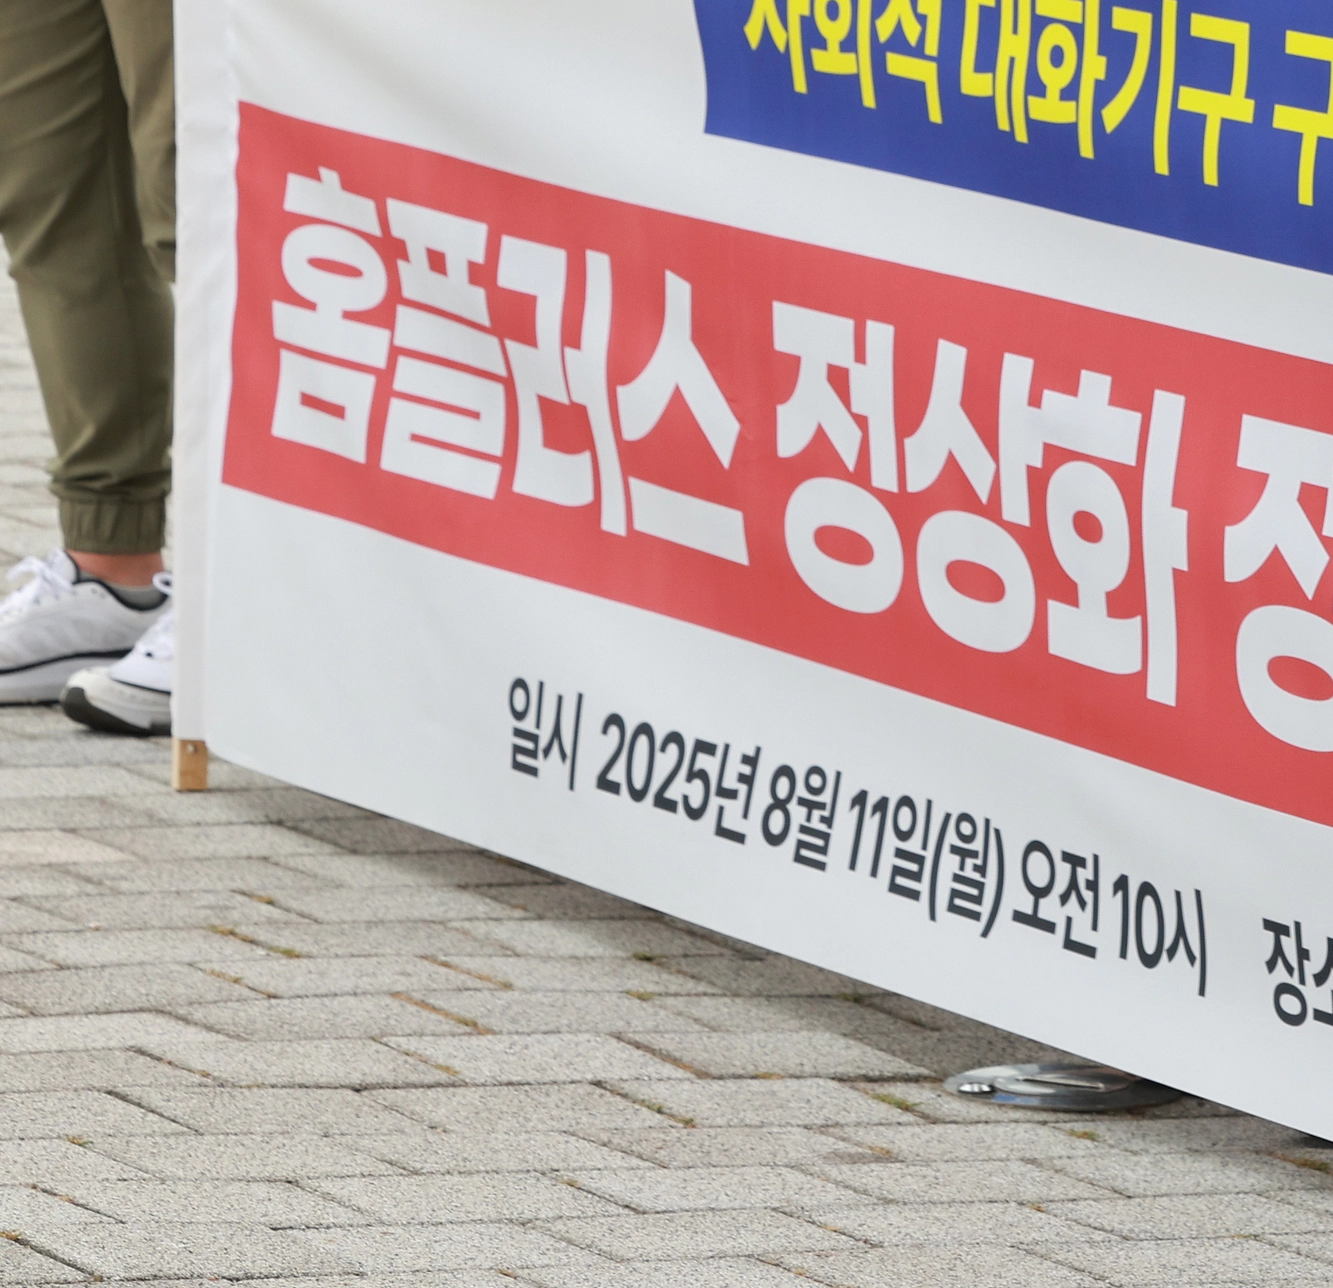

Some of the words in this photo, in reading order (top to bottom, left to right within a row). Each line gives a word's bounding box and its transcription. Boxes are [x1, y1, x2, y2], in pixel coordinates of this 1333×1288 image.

[270, 166, 750, 567] 홈플러스
[772, 299, 1189, 707] 정상화
[507, 677, 584, 792] 일시
[595, 712, 762, 845] 2025년
[761, 763, 842, 872] 8월
[849, 786, 1005, 939] 11일(월)
[1012, 839, 1100, 960] 오전
[1112, 874, 1208, 998] 10시
